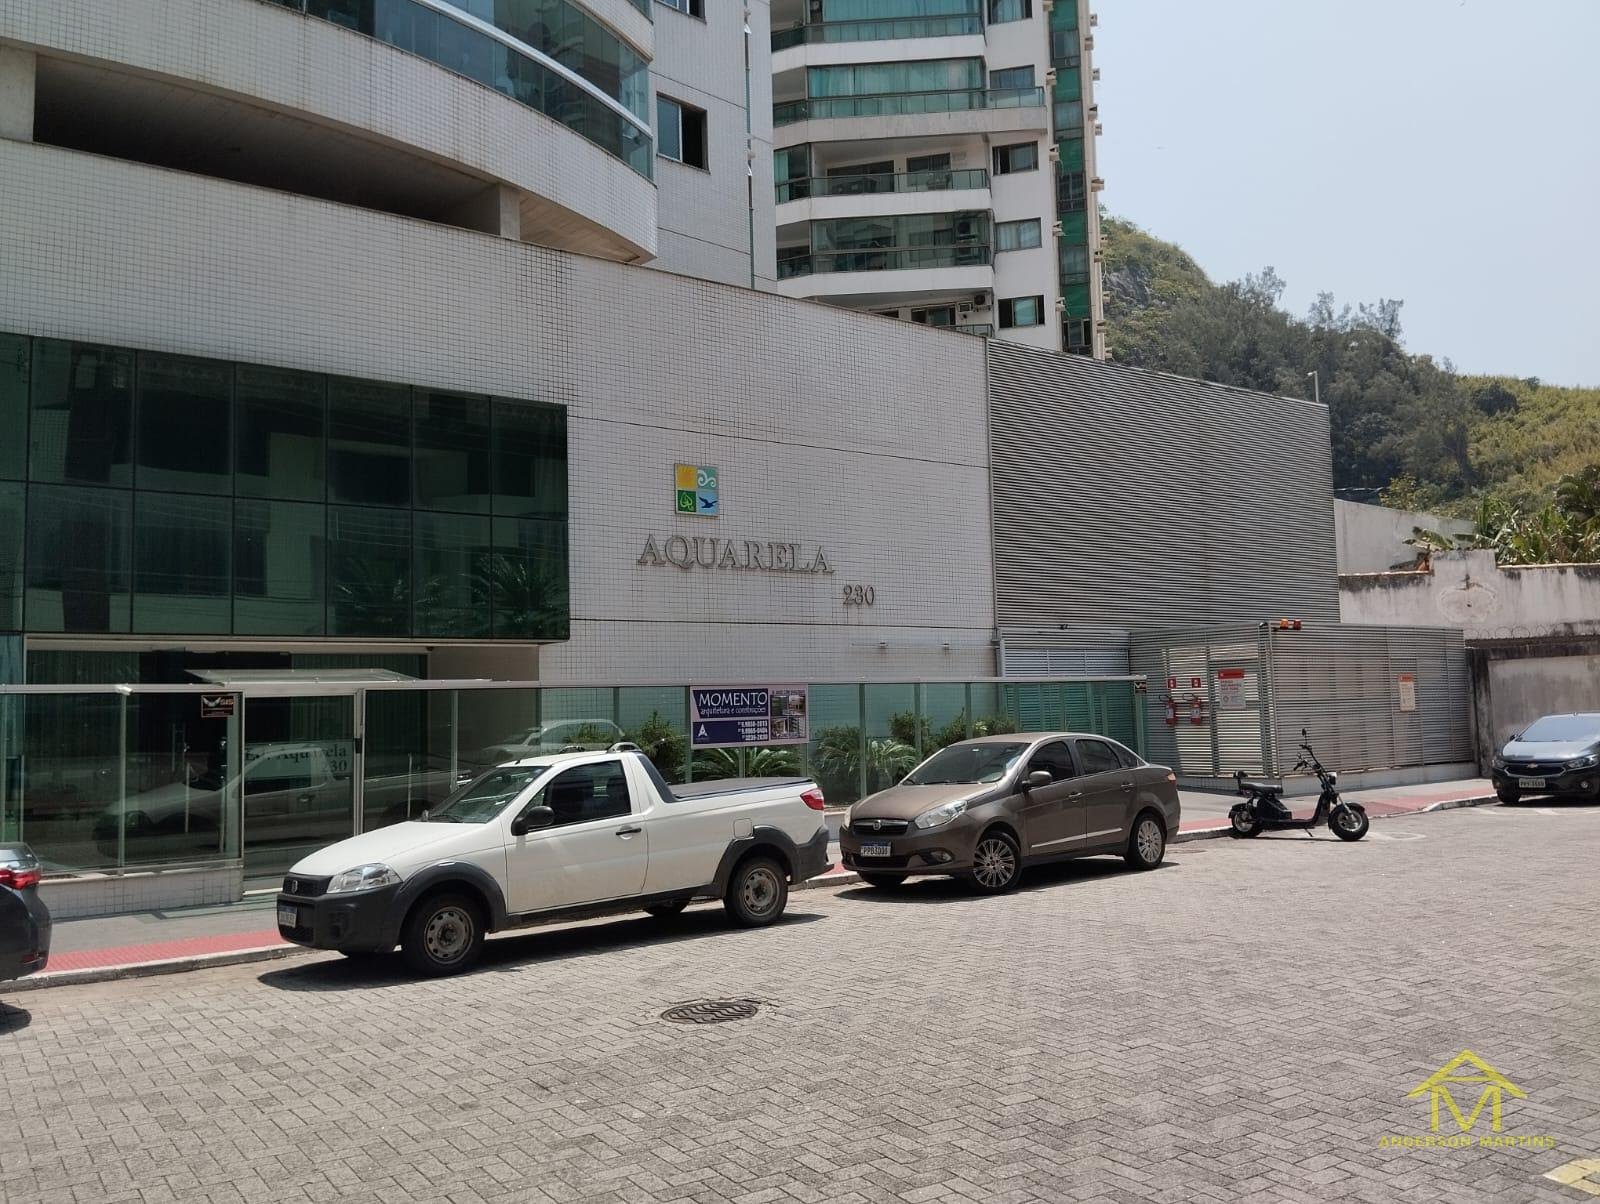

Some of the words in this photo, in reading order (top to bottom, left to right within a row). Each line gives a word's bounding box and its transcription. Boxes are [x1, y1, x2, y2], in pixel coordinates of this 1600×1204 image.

[637, 534, 835, 575] AQUARELA
[843, 584, 875, 606] 230
[699, 691, 768, 707] MOMENTO
